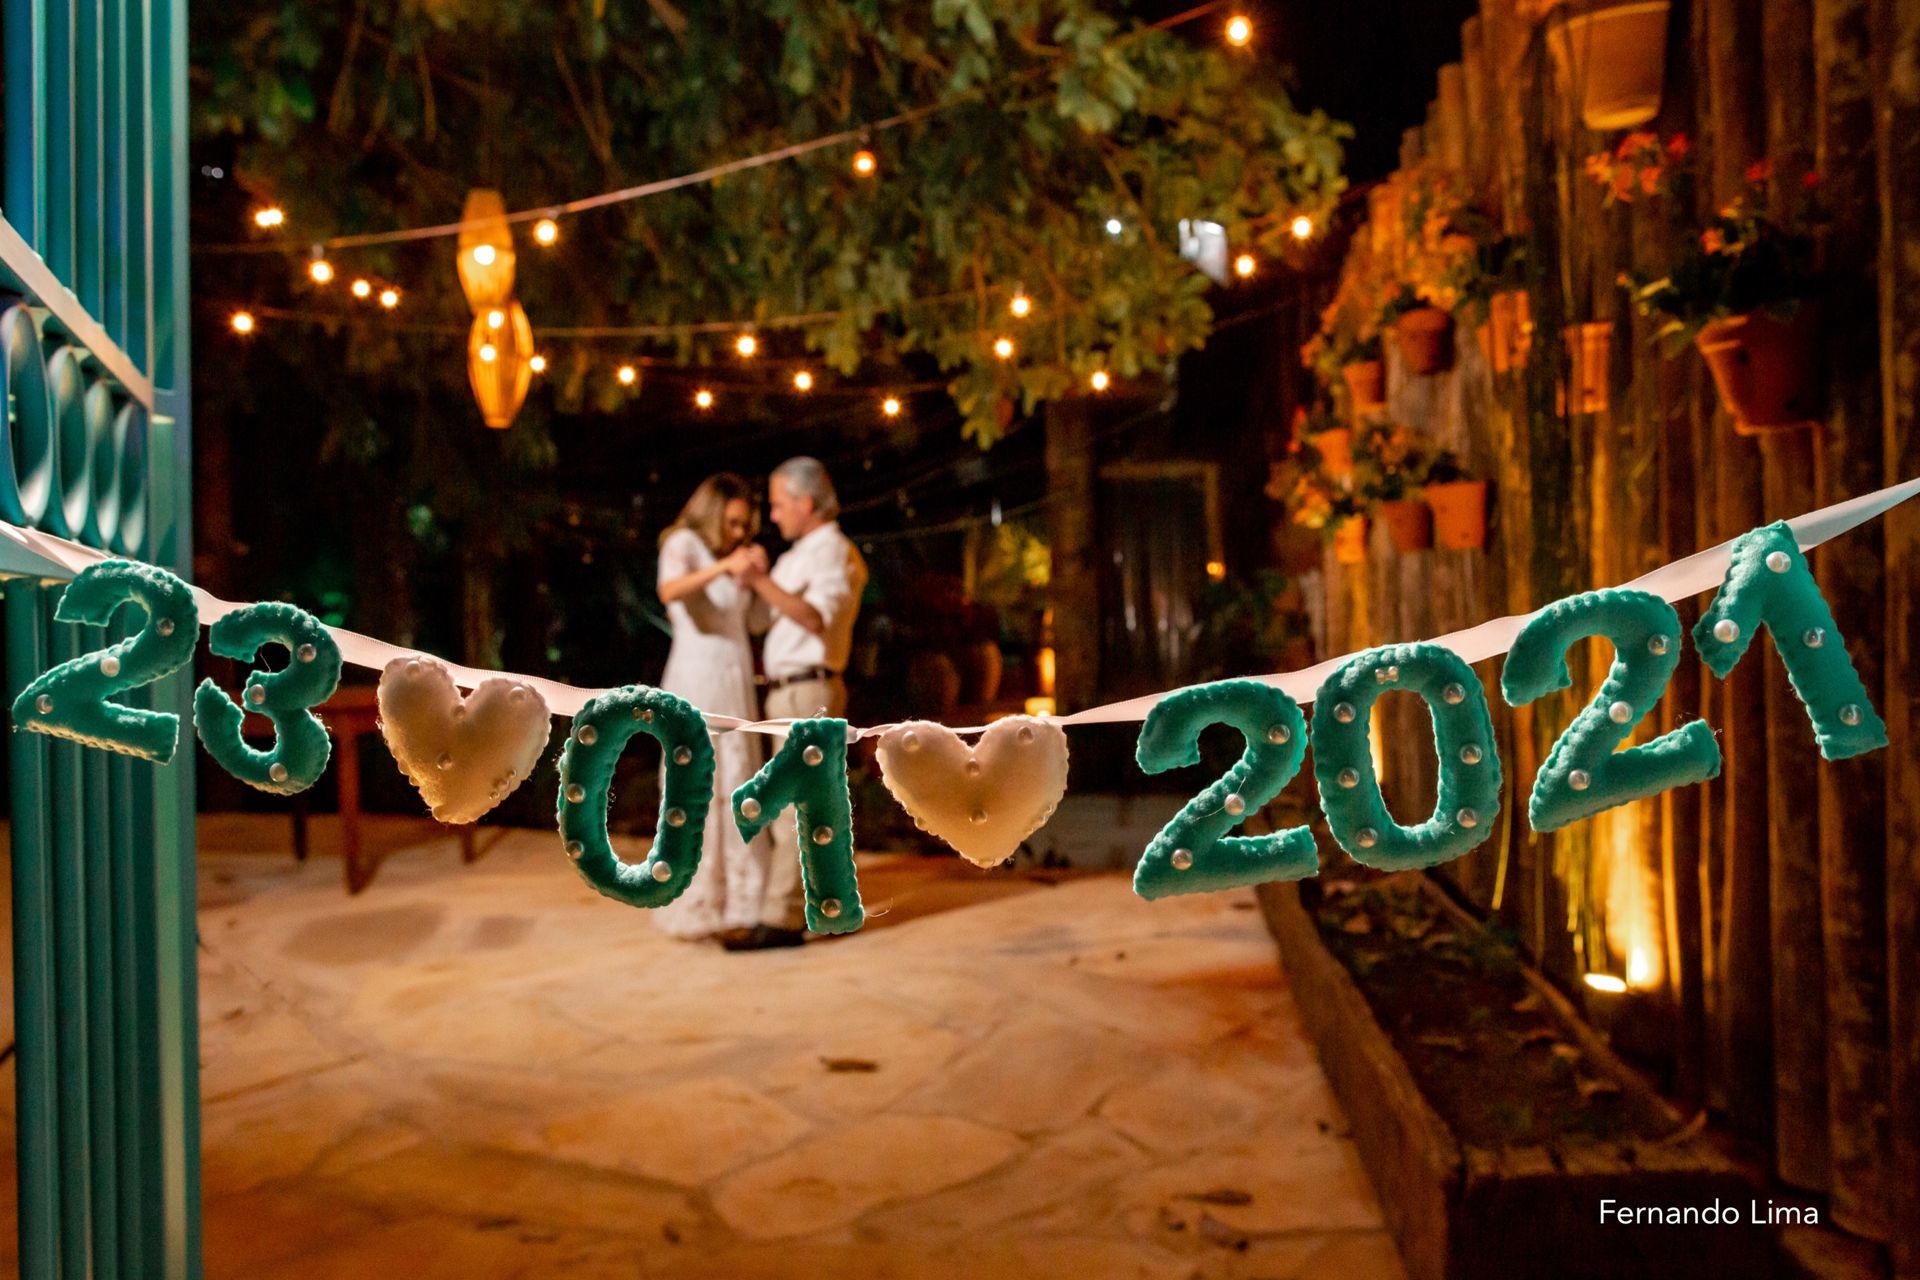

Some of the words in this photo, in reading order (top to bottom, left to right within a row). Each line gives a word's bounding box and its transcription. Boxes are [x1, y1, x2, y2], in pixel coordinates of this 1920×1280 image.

[12, 558, 342, 796] 23
[557, 684, 864, 934] 01
[1133, 520, 1888, 901] 2021
